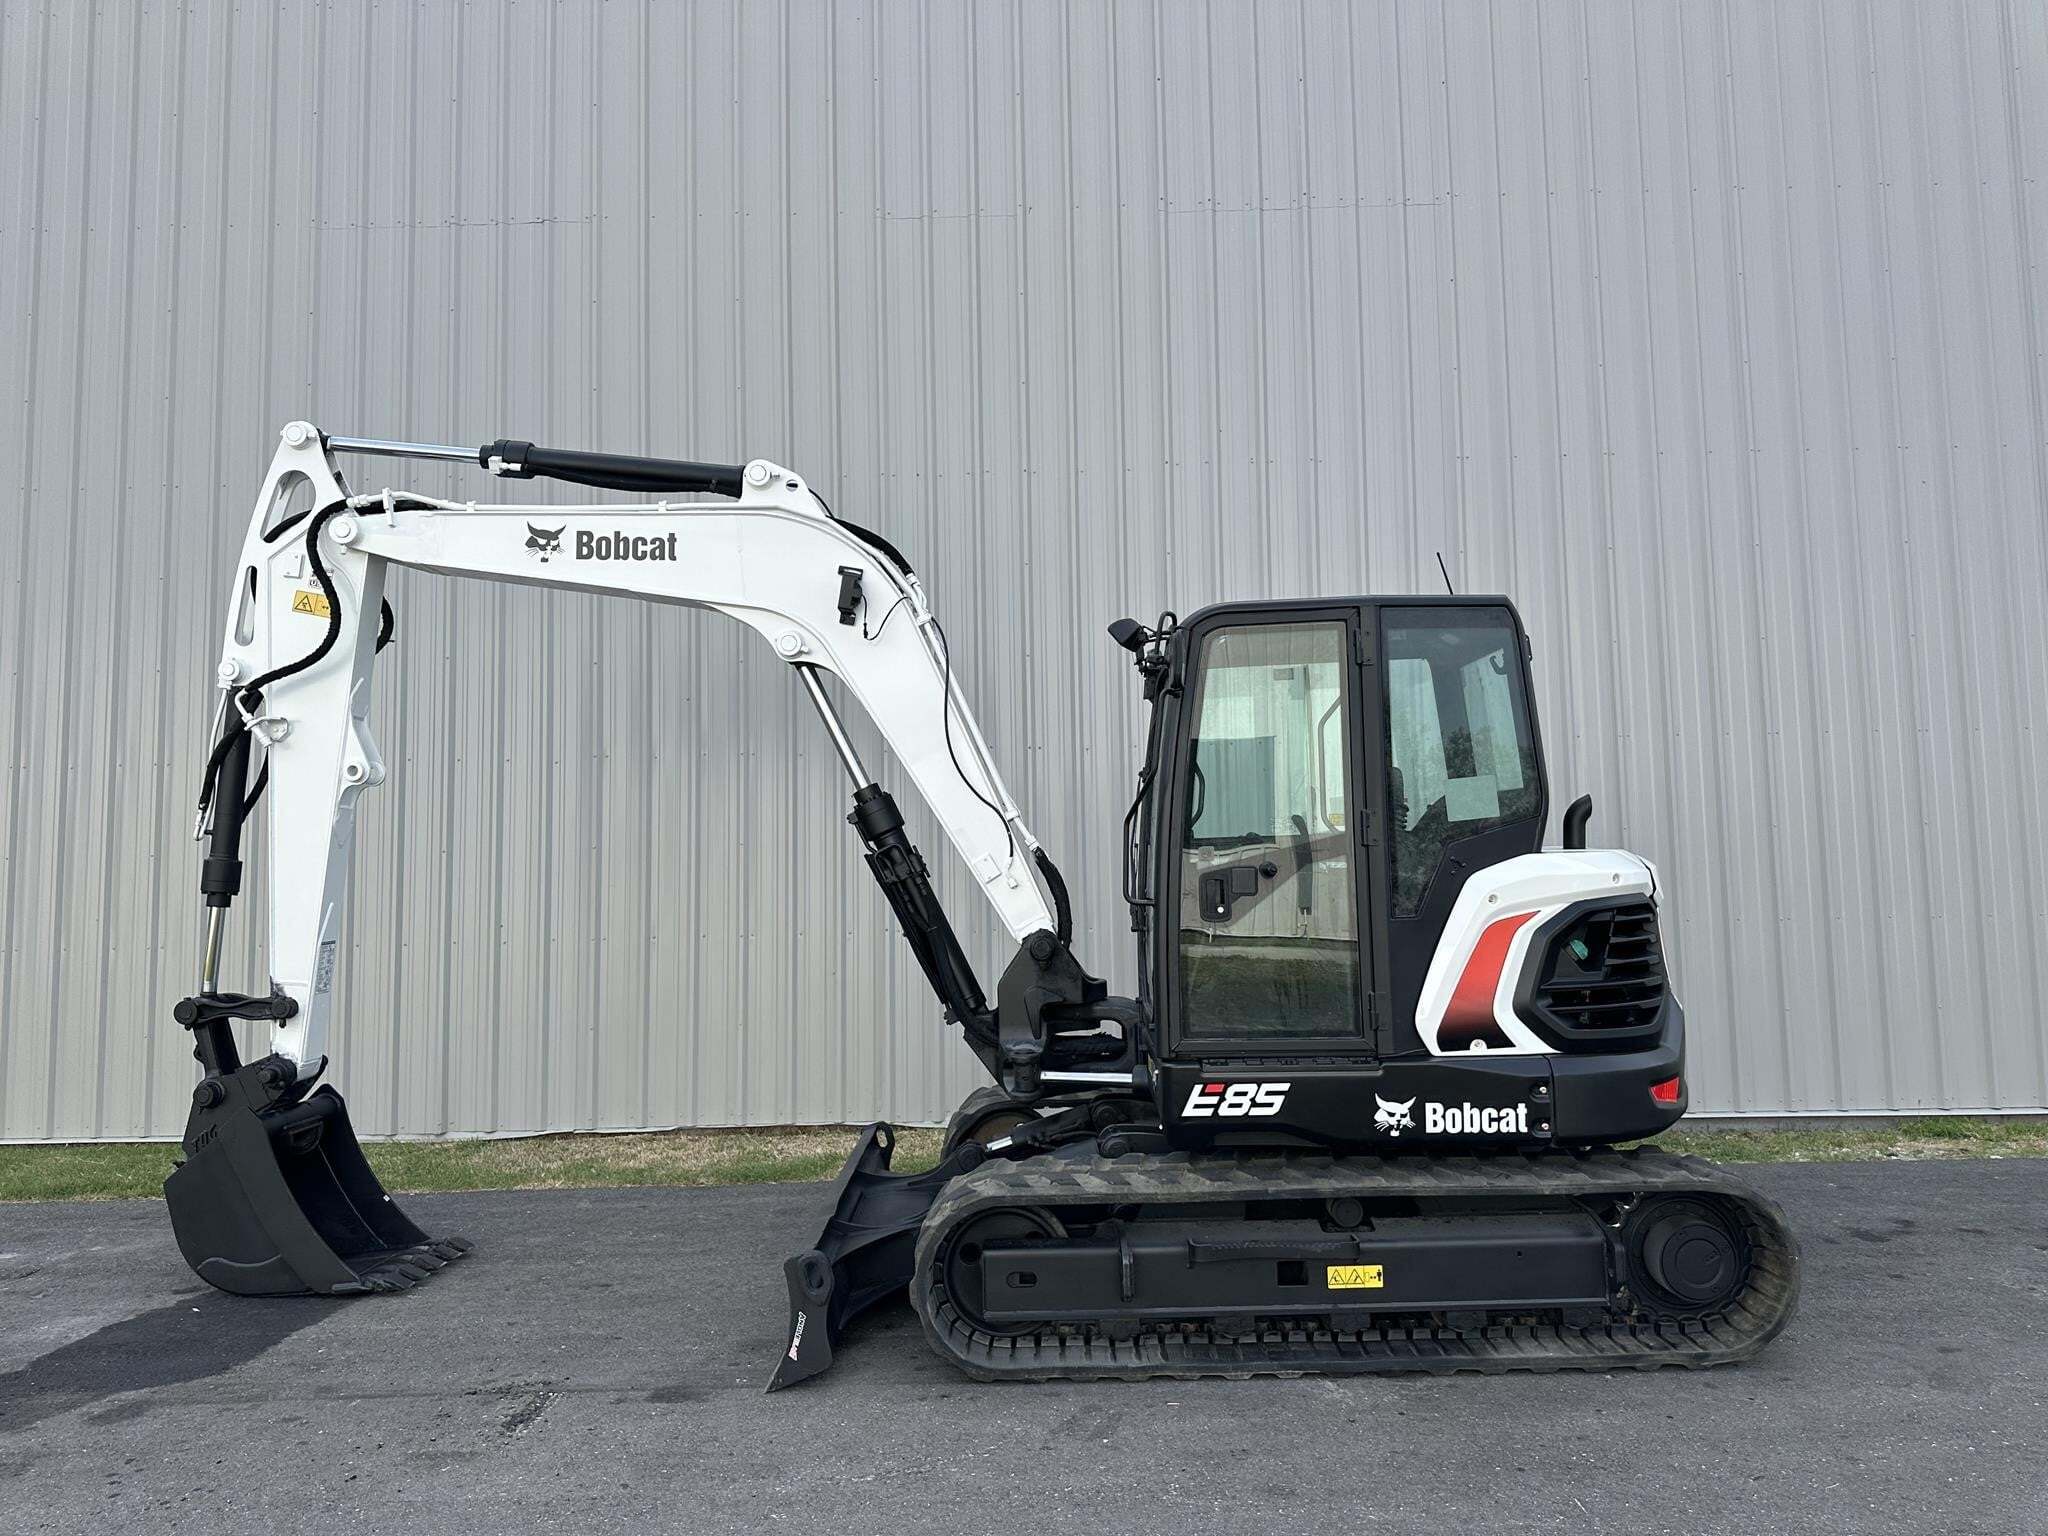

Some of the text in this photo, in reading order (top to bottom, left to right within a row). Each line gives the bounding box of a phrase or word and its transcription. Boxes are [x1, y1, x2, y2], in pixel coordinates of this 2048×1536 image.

[575, 530, 677, 561] Bobcat
[1181, 1082, 1291, 1117] E85
[1425, 1102, 1528, 1134] Bobcat
